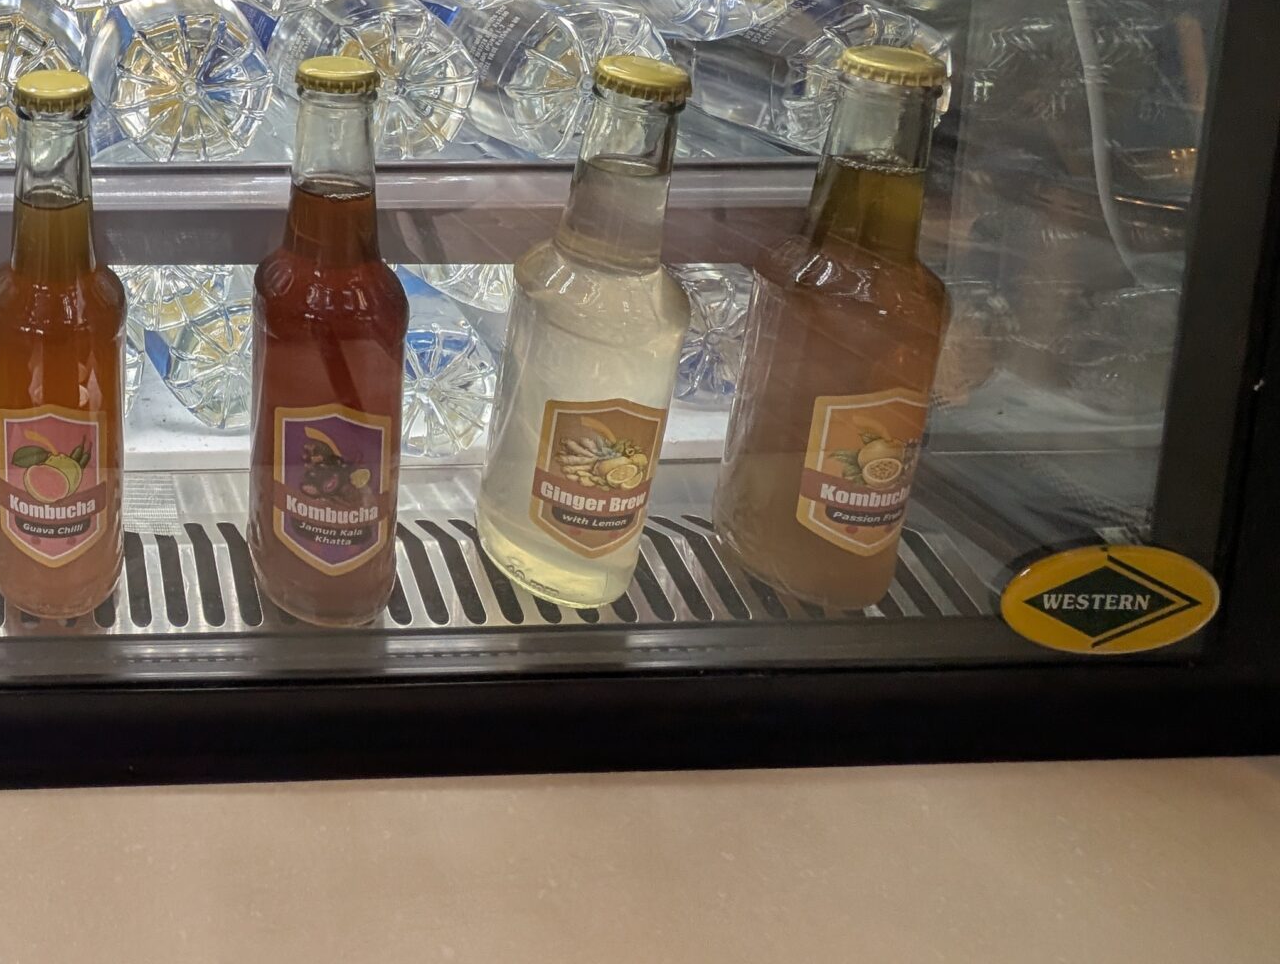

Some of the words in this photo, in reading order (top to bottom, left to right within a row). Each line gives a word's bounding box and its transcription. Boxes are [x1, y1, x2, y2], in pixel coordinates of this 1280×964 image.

[540, 480, 607, 513] Ginger
[819, 482, 911, 509] Kombuch
[9, 494, 96, 520] Kombucha
[286, 494, 379, 525] Kombucha
[561, 513, 589, 527] with
[591, 515, 627, 528] Lemon
[832, 510, 881, 524] Passion
[22, 523, 55, 535] Guava
[56, 522, 84, 535] Chilli
[298, 521, 338, 536] Jamun
[340, 526, 364, 537] Kala
[314, 534, 353, 547] Khatta
[1041, 593, 1151, 612] WESTERN
